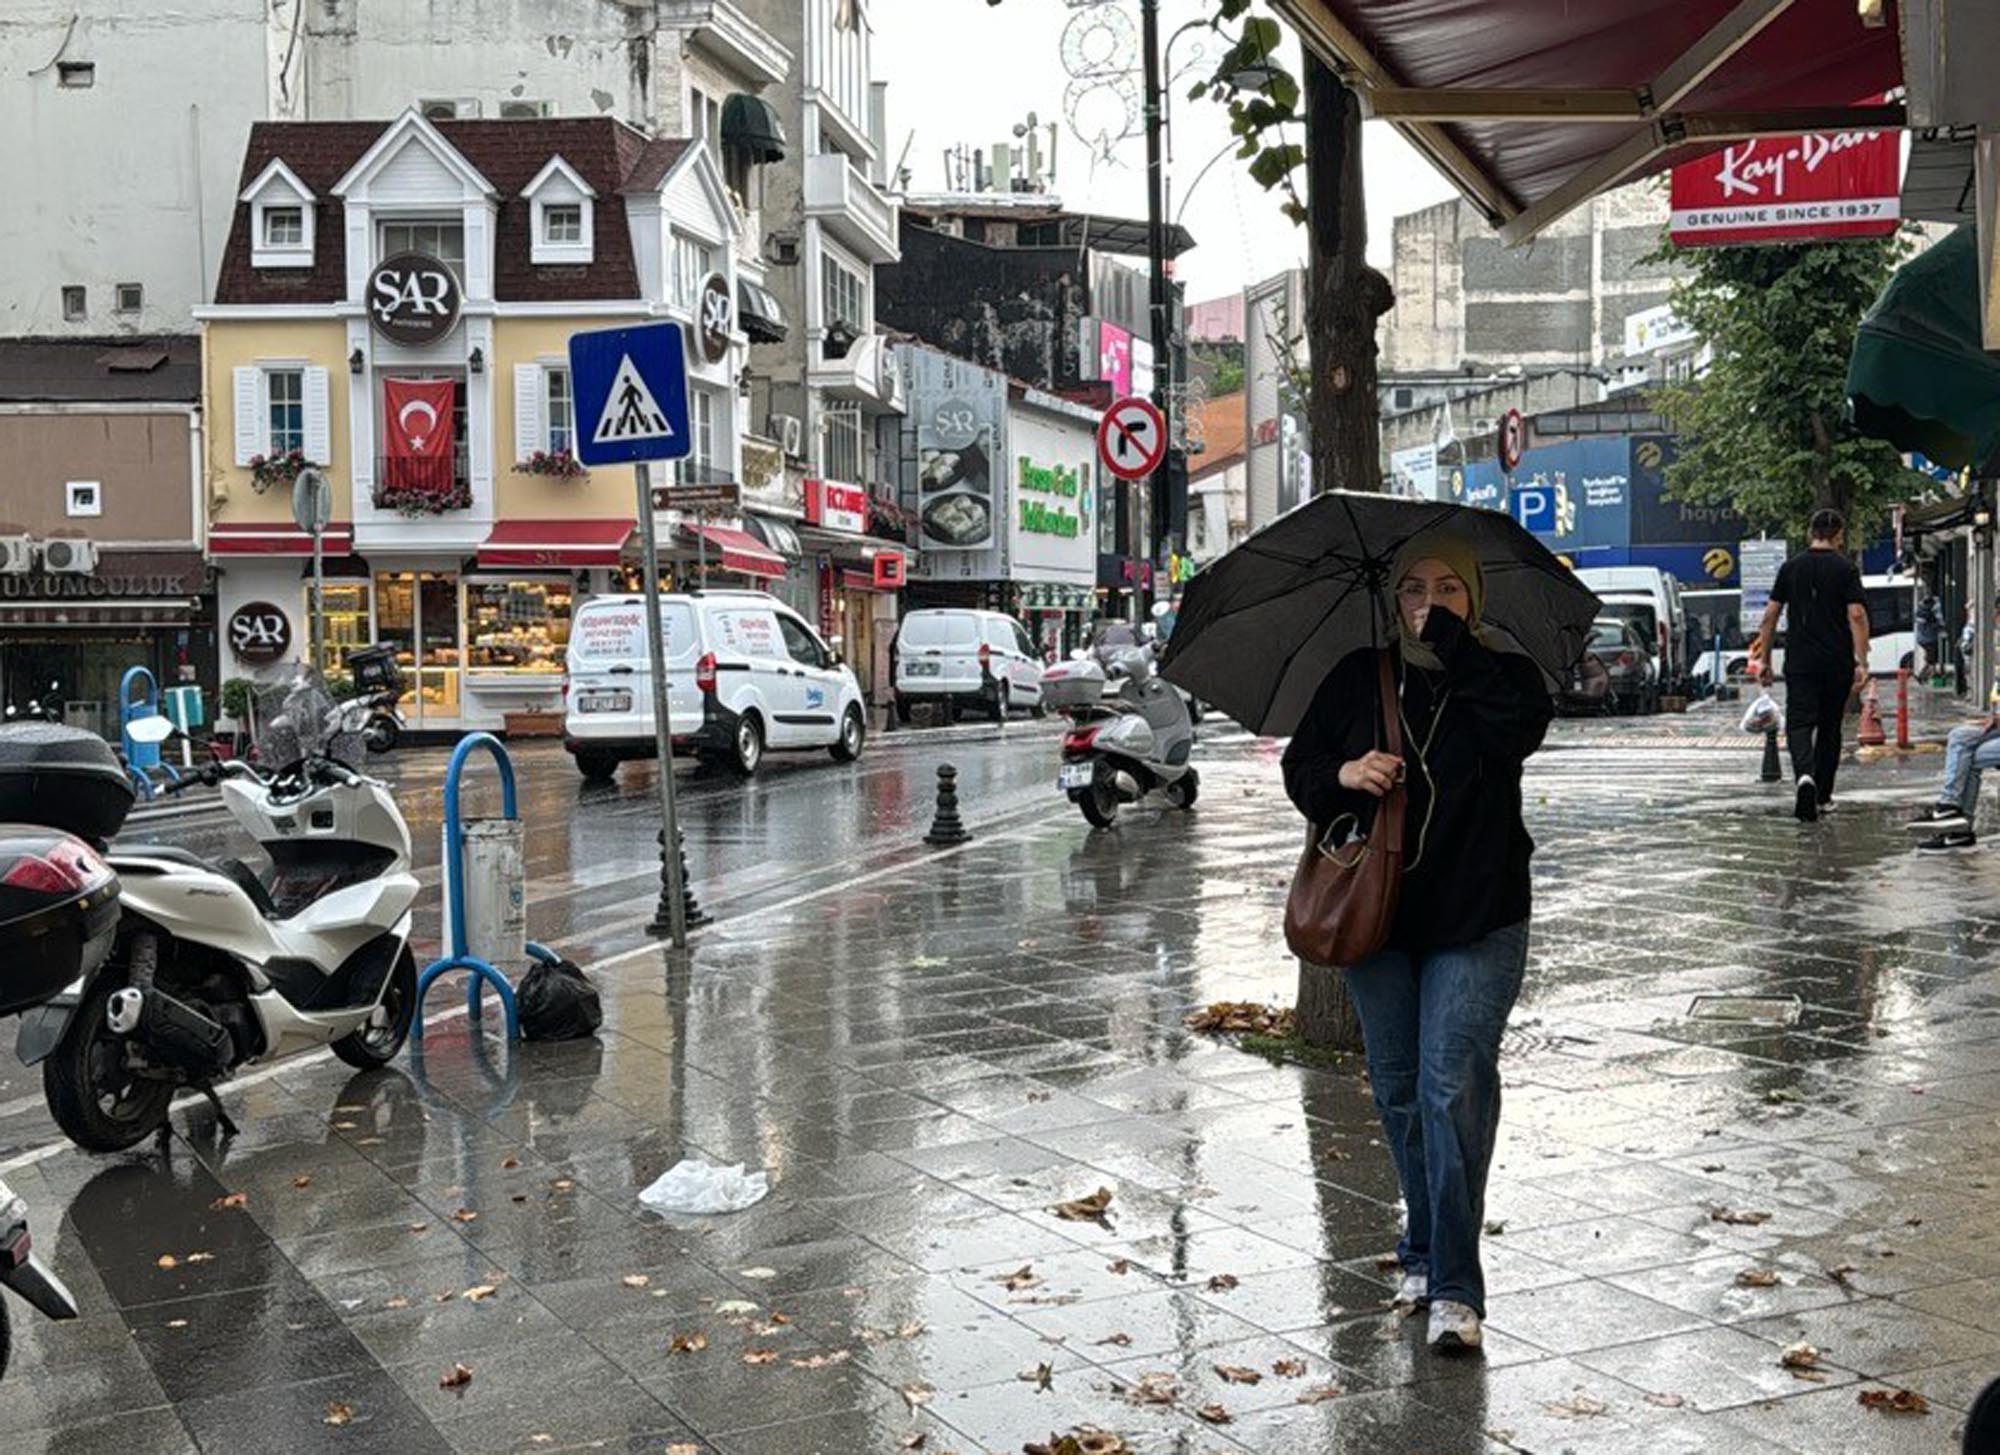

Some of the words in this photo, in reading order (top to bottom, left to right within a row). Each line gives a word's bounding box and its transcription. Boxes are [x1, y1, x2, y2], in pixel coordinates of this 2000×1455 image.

[1686, 209, 1768, 227] GENUINE
[1775, 205, 1832, 222] SINCE
[1838, 203, 1882, 217] 1937
[372, 269, 450, 322] ŞAR
[1519, 491, 1546, 528] P
[232, 615, 284, 651] ŞAR
